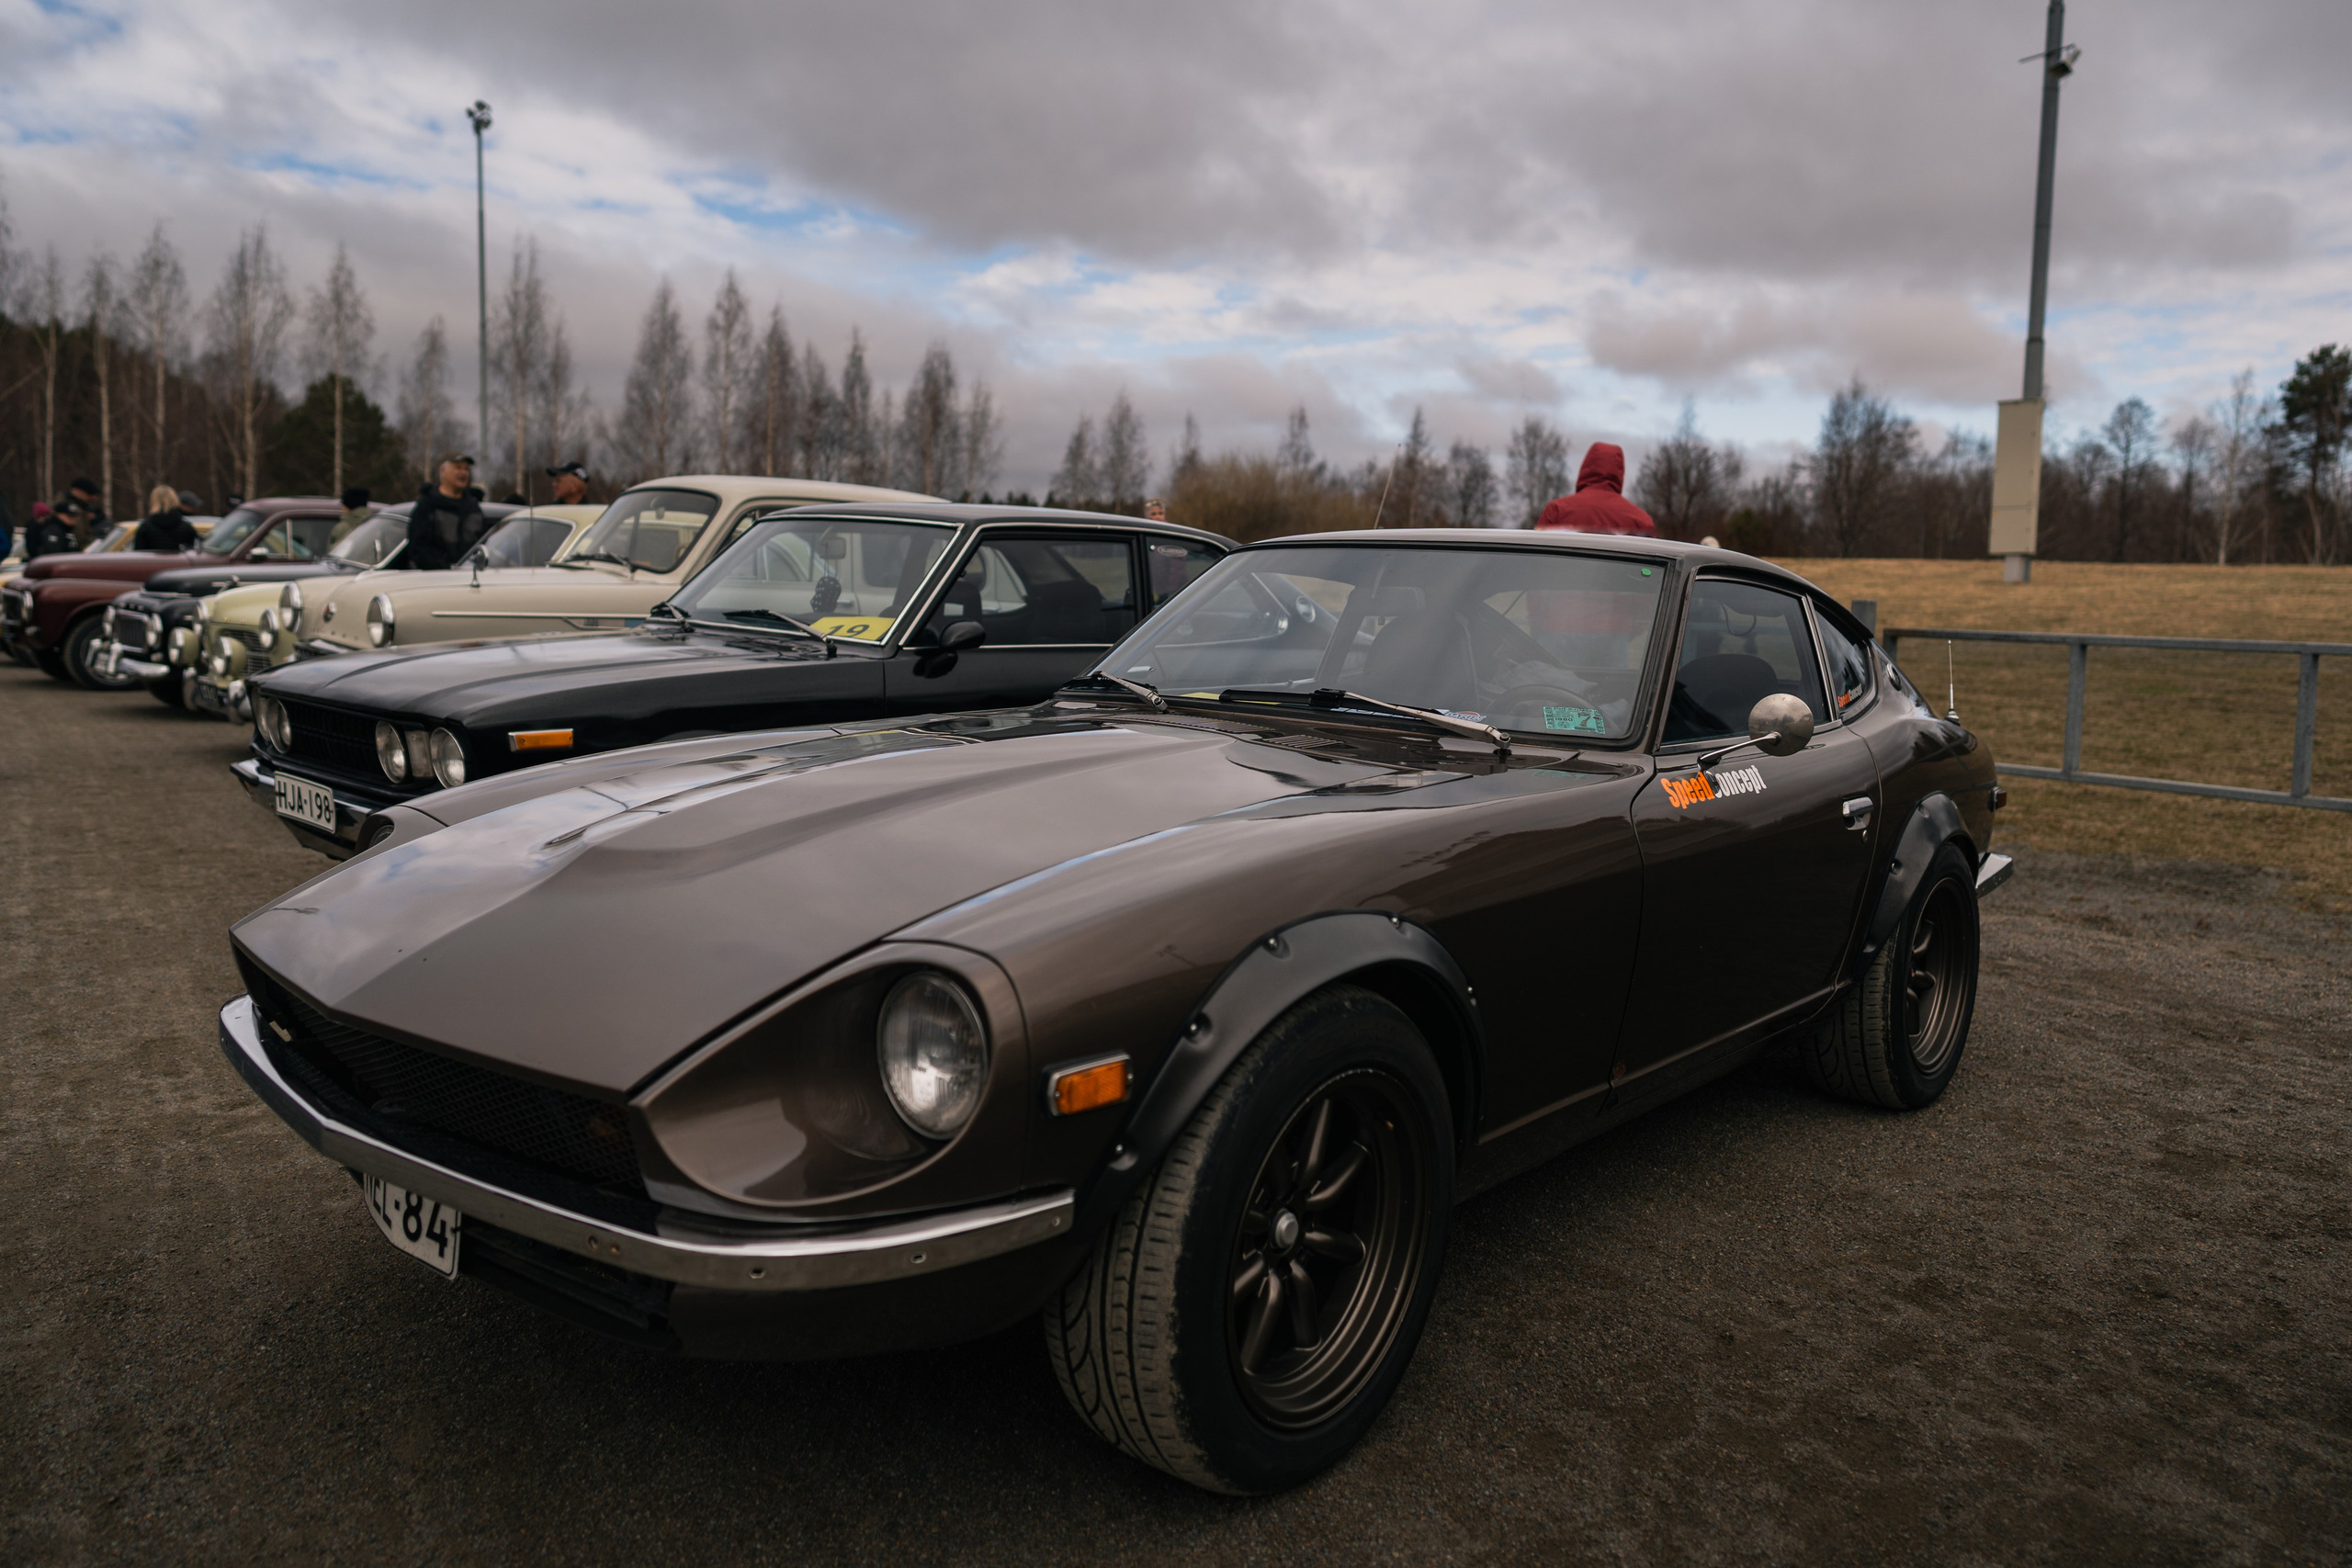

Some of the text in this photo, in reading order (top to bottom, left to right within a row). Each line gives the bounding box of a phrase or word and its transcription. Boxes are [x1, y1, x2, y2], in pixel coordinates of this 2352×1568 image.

[827, 624, 870, 637] 19
[1444, 711, 1485, 723] DATSUN
[277, 780, 332, 824] HJA-198
